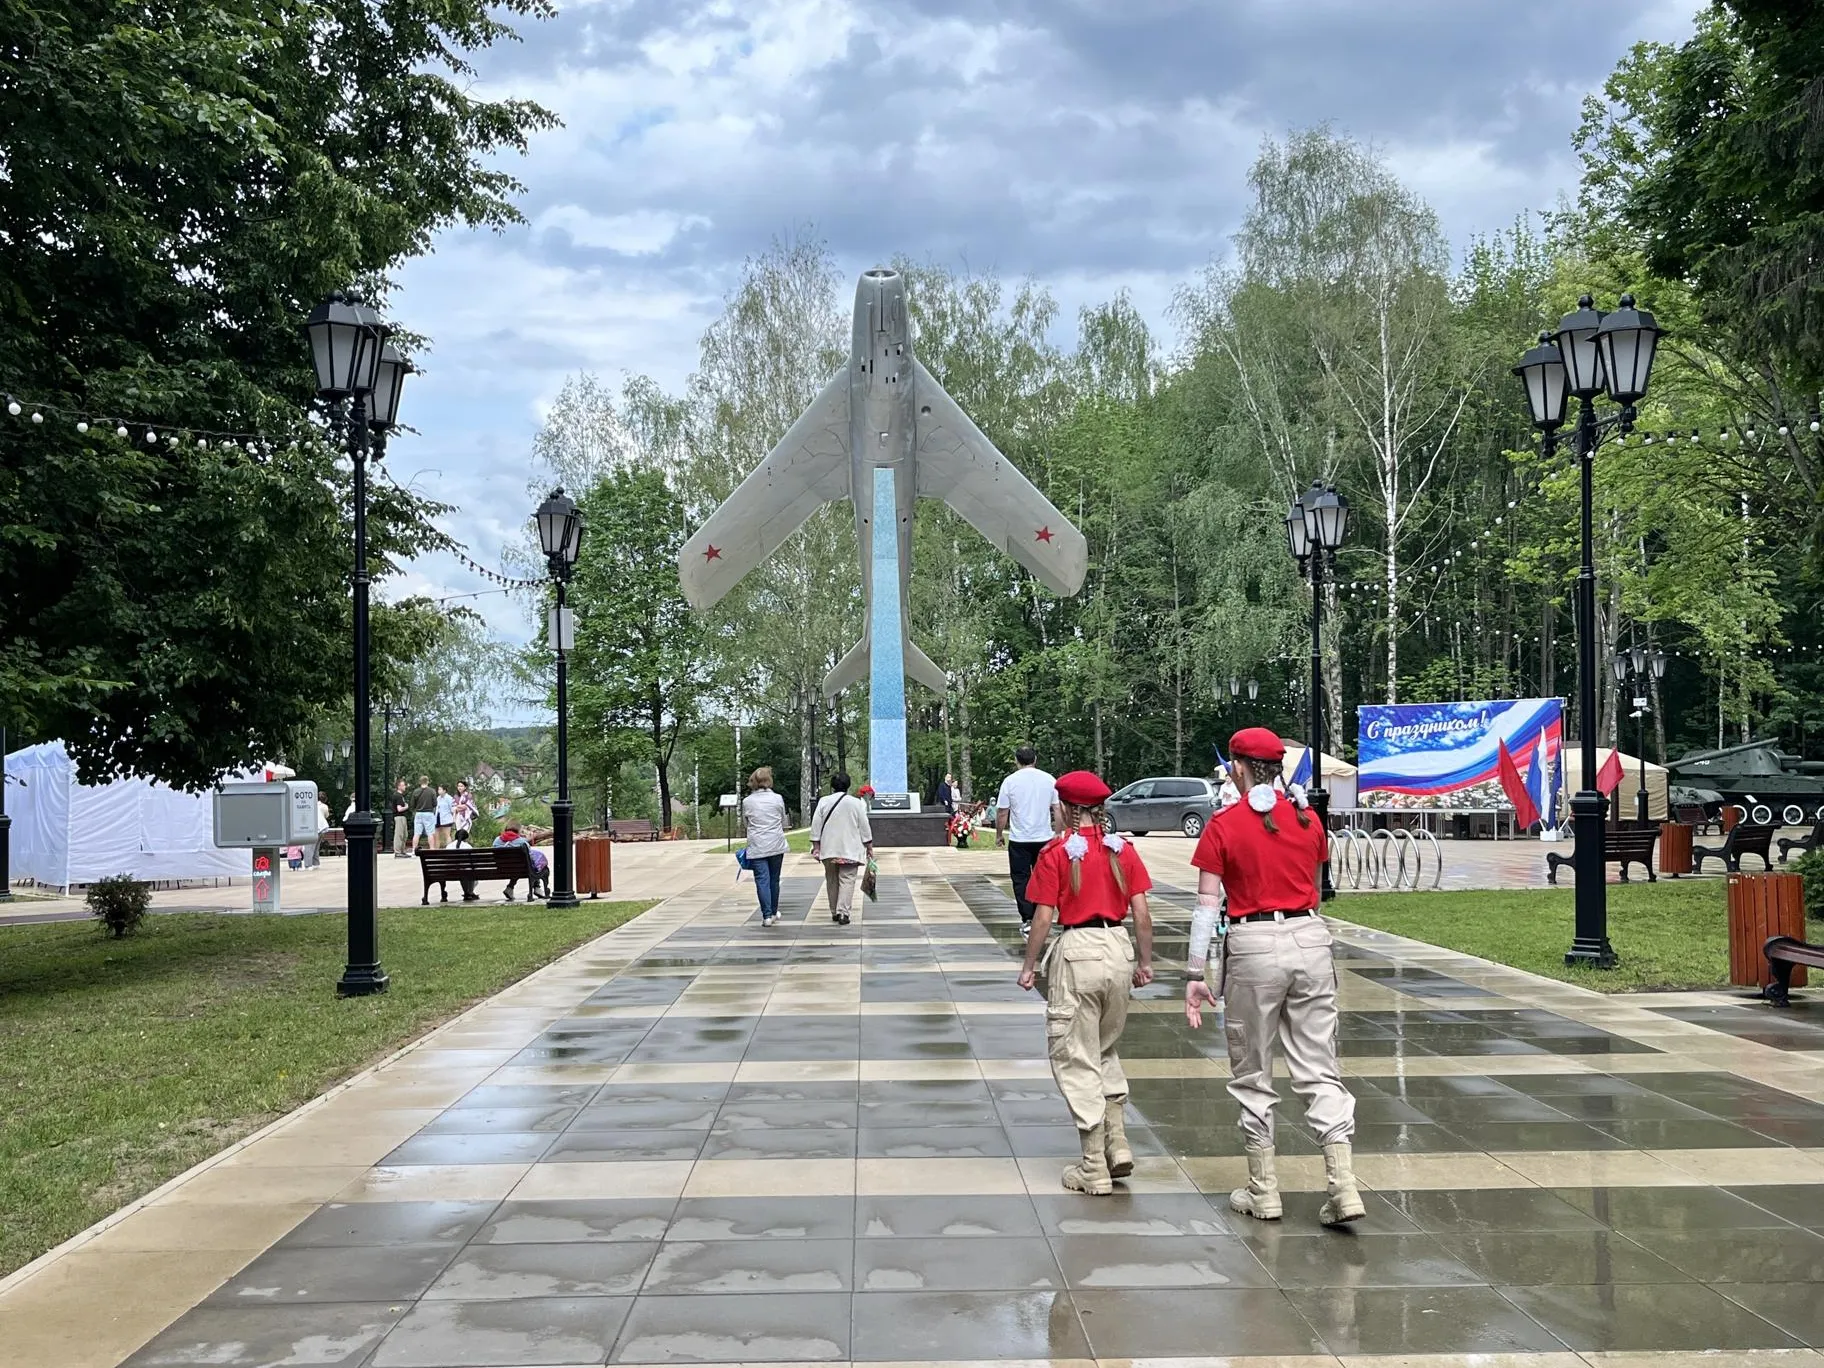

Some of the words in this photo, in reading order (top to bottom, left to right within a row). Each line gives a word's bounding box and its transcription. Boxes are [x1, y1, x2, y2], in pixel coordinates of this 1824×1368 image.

[1367, 721, 1380, 739] С
[1384, 711, 1486, 741] праздником!
[295, 791, 313, 799] ФОТО
